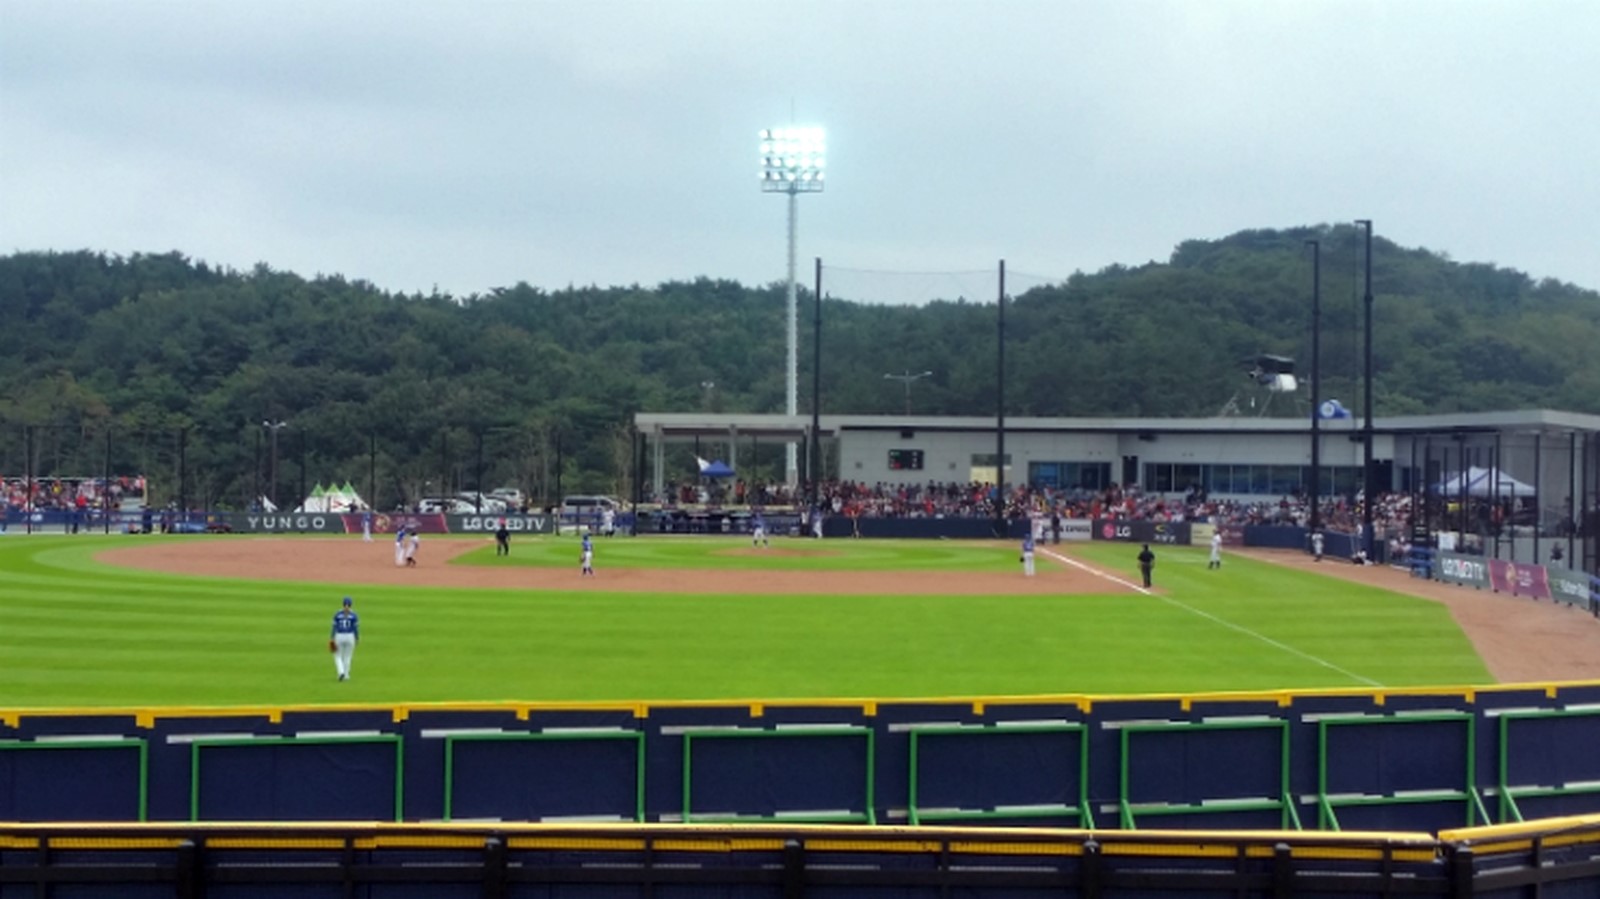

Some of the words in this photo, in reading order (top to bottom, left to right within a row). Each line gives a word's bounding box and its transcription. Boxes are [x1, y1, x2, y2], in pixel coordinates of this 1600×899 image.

[247, 516, 326, 529] YUNGO
[463, 517, 482, 531] LG
[526, 517, 545, 531] TV
[1116, 526, 1131, 537] LG
